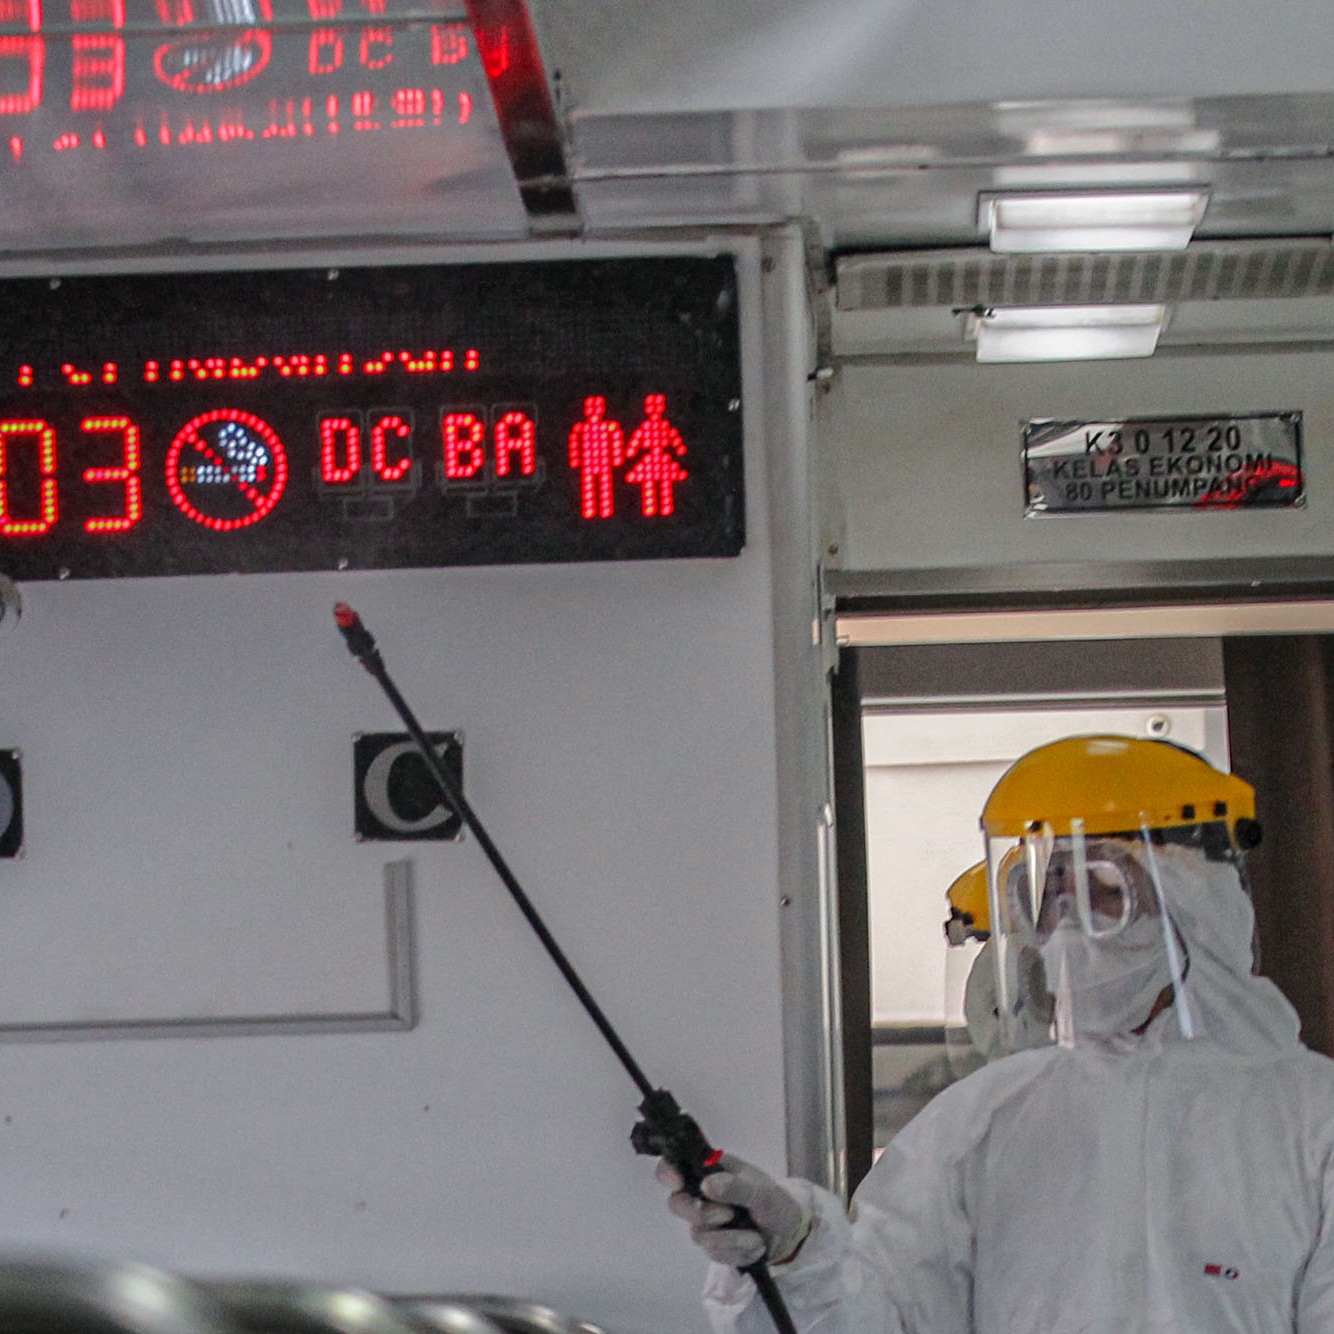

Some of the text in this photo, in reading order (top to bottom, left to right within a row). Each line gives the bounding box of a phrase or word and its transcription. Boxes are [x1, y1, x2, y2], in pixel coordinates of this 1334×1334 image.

[1085, 426, 1241, 455] K3 0 12 20
[1052, 453, 1273, 480] KELAS EKONOMI
[1065, 482, 1092, 501] 80
[363, 741, 454, 832] C
